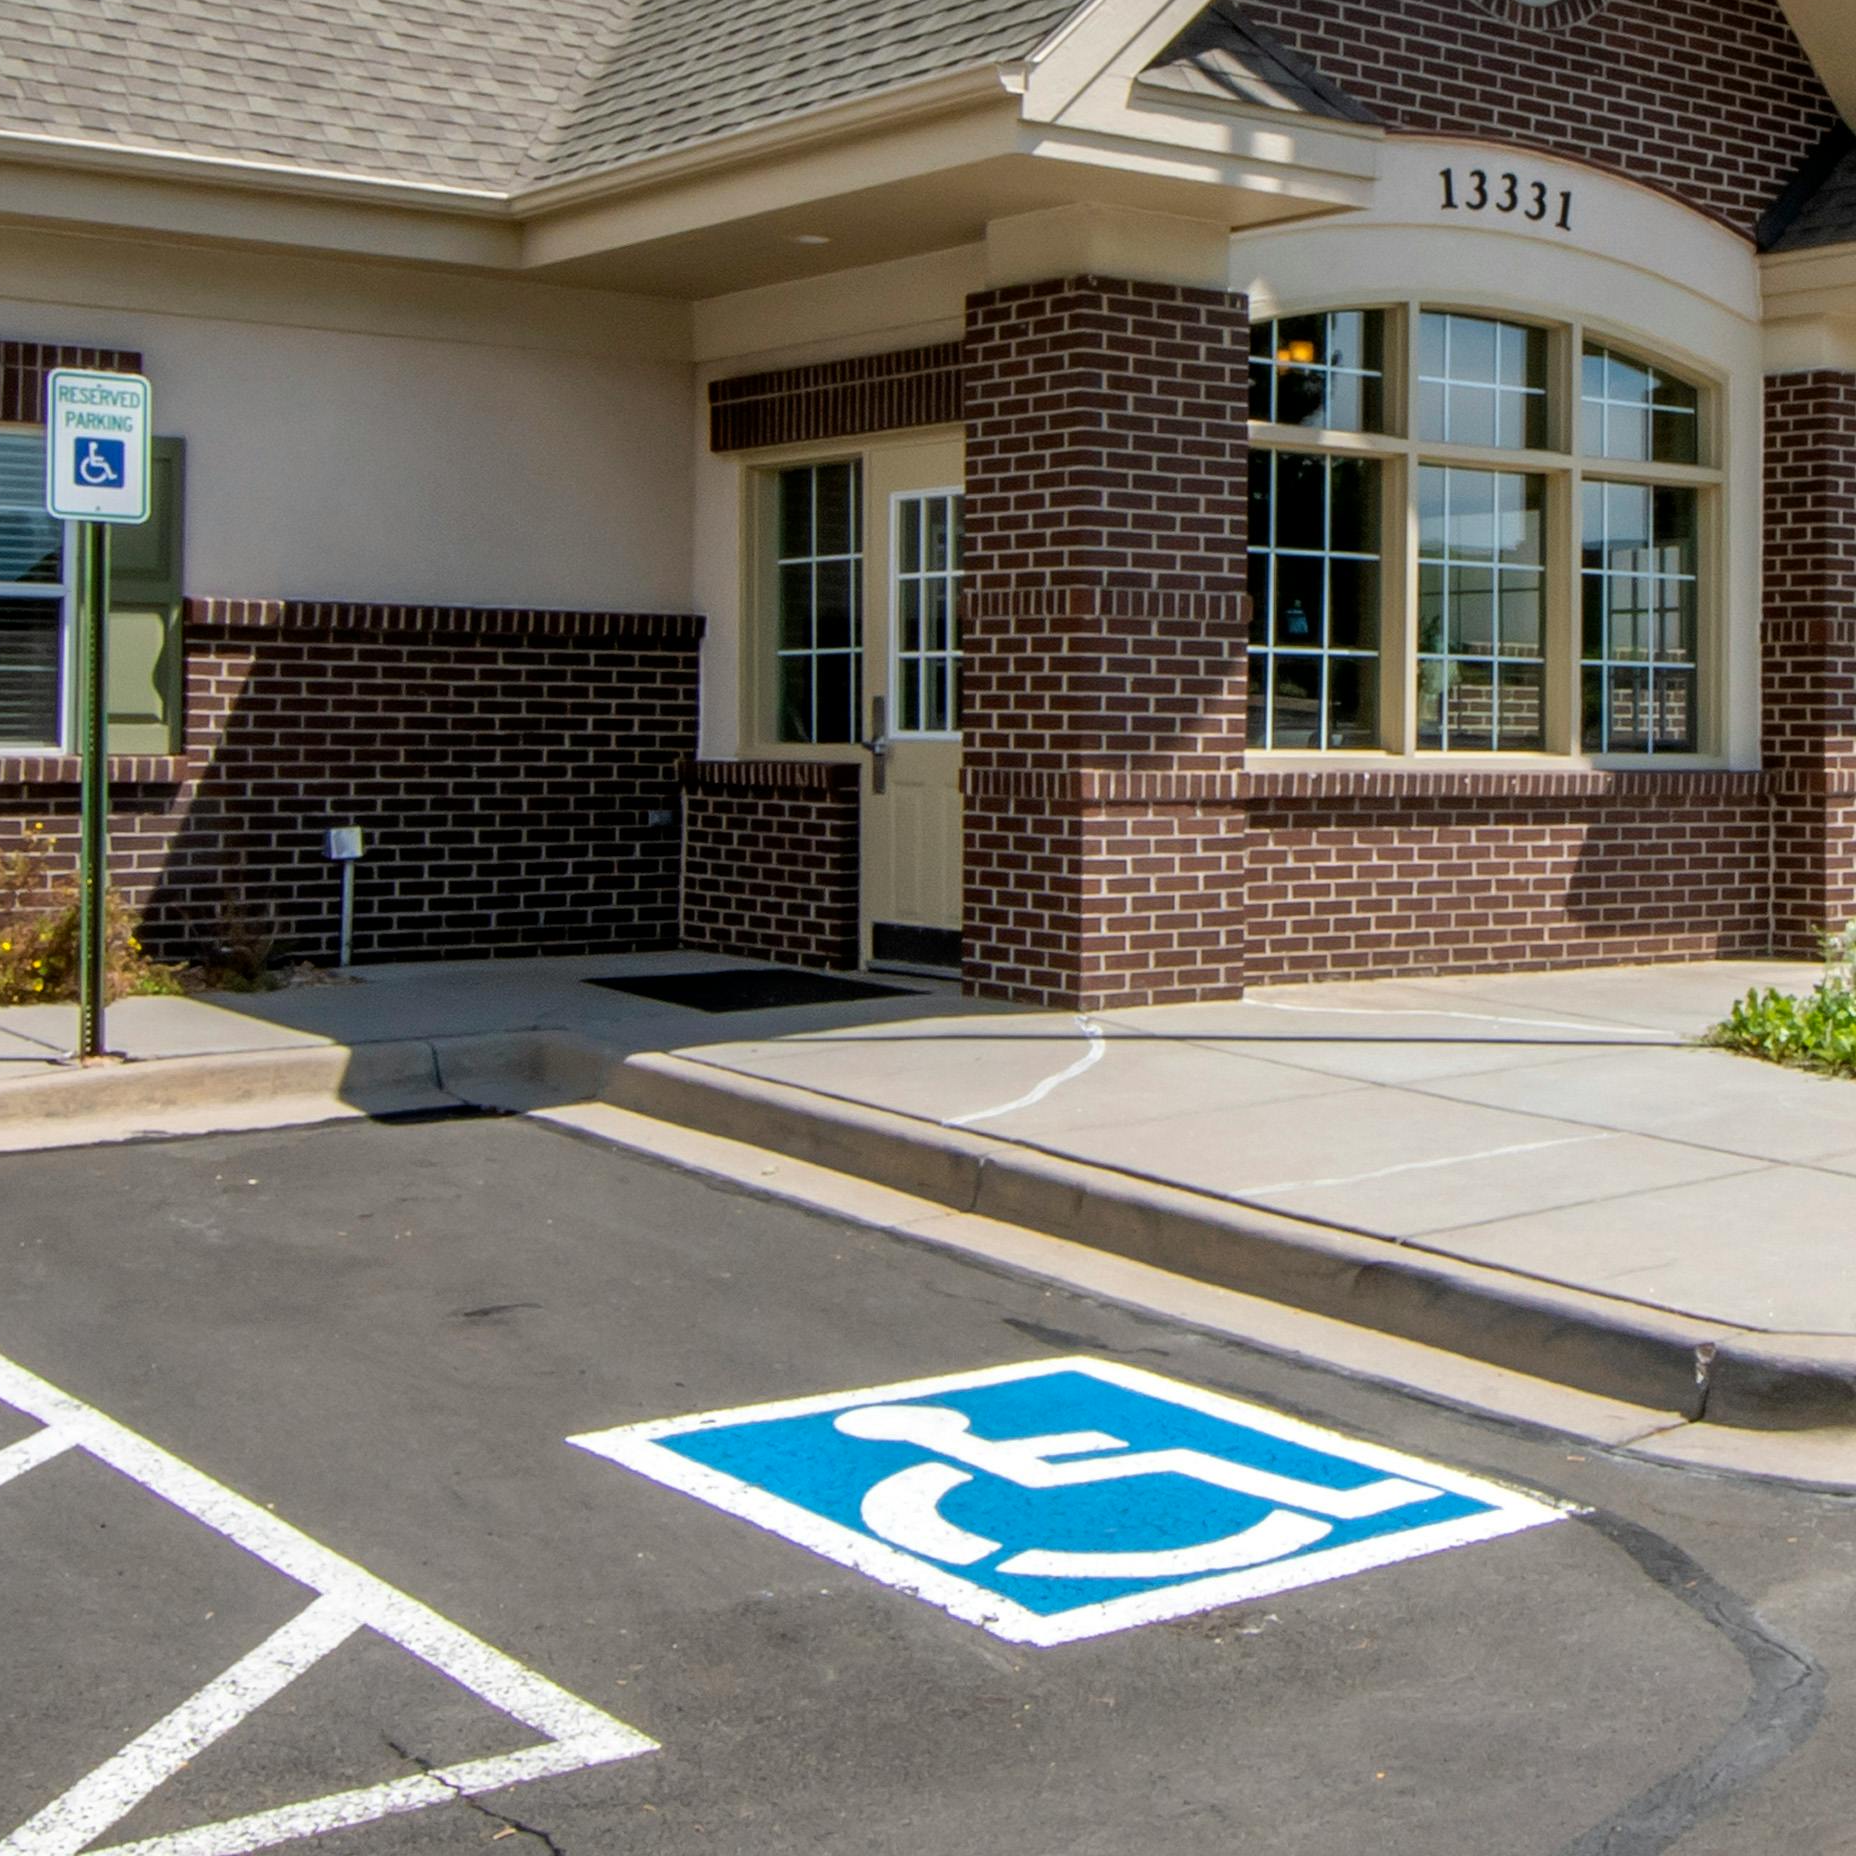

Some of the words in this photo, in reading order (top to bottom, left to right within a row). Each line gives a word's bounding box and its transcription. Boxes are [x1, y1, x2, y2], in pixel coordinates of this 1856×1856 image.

[1439, 167, 1572, 232] 13331
[58, 384, 141, 409] RESERVED
[65, 410, 134, 433] PARKING
